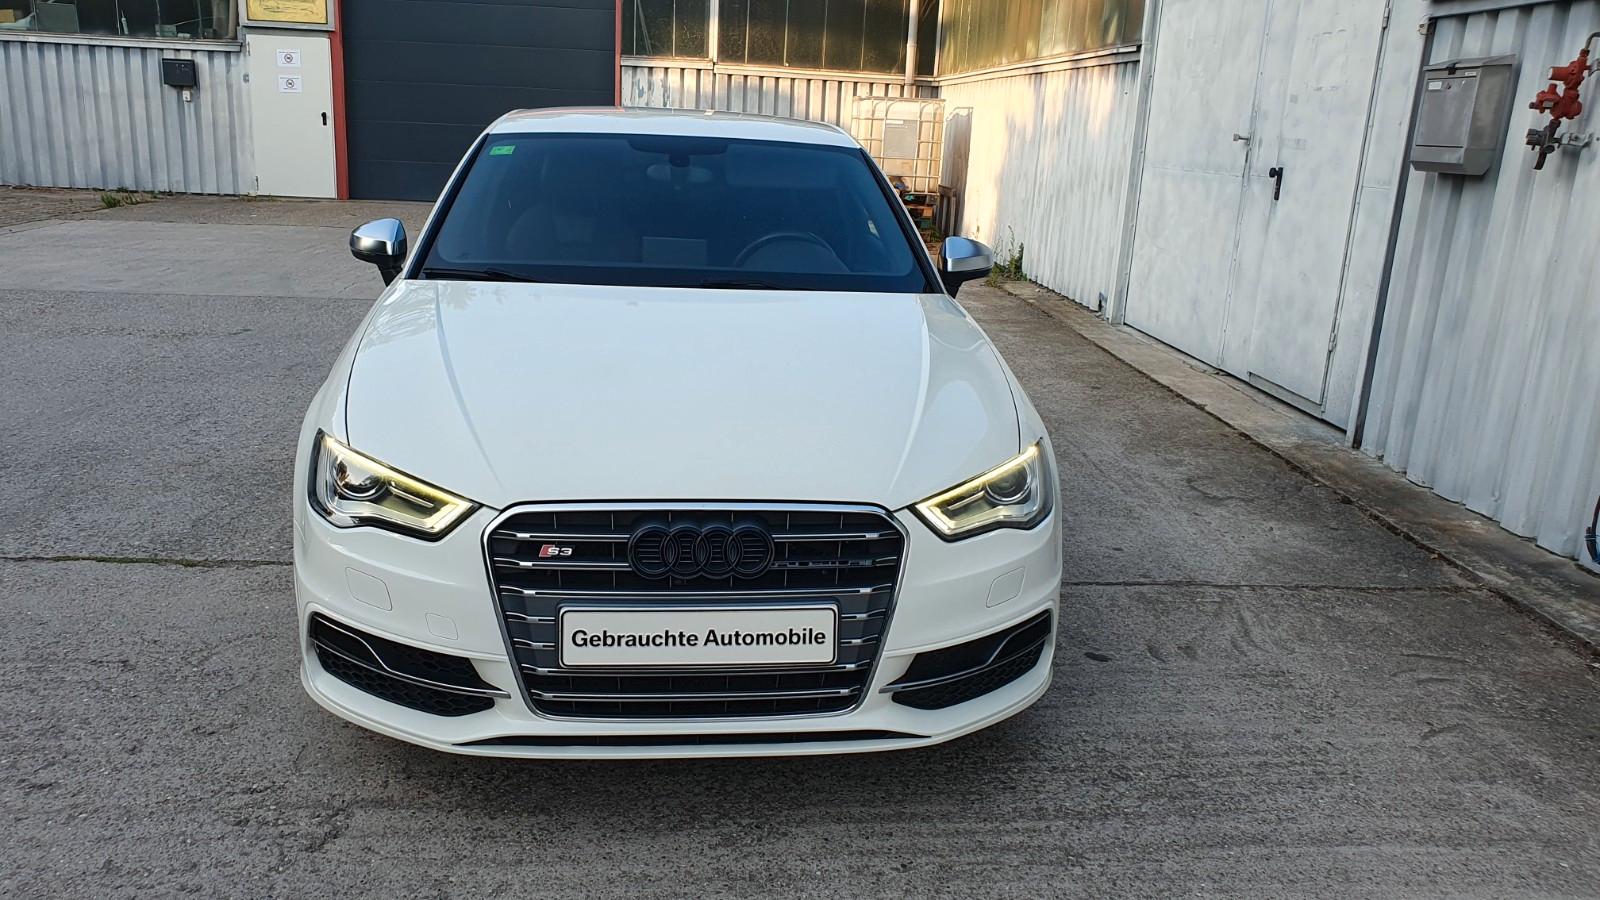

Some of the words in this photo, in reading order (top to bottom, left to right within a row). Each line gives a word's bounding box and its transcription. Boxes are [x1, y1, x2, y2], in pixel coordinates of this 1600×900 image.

[547, 547, 573, 556] S3
[571, 628, 699, 648] Gebrauchte
[703, 627, 827, 647] Automobile
